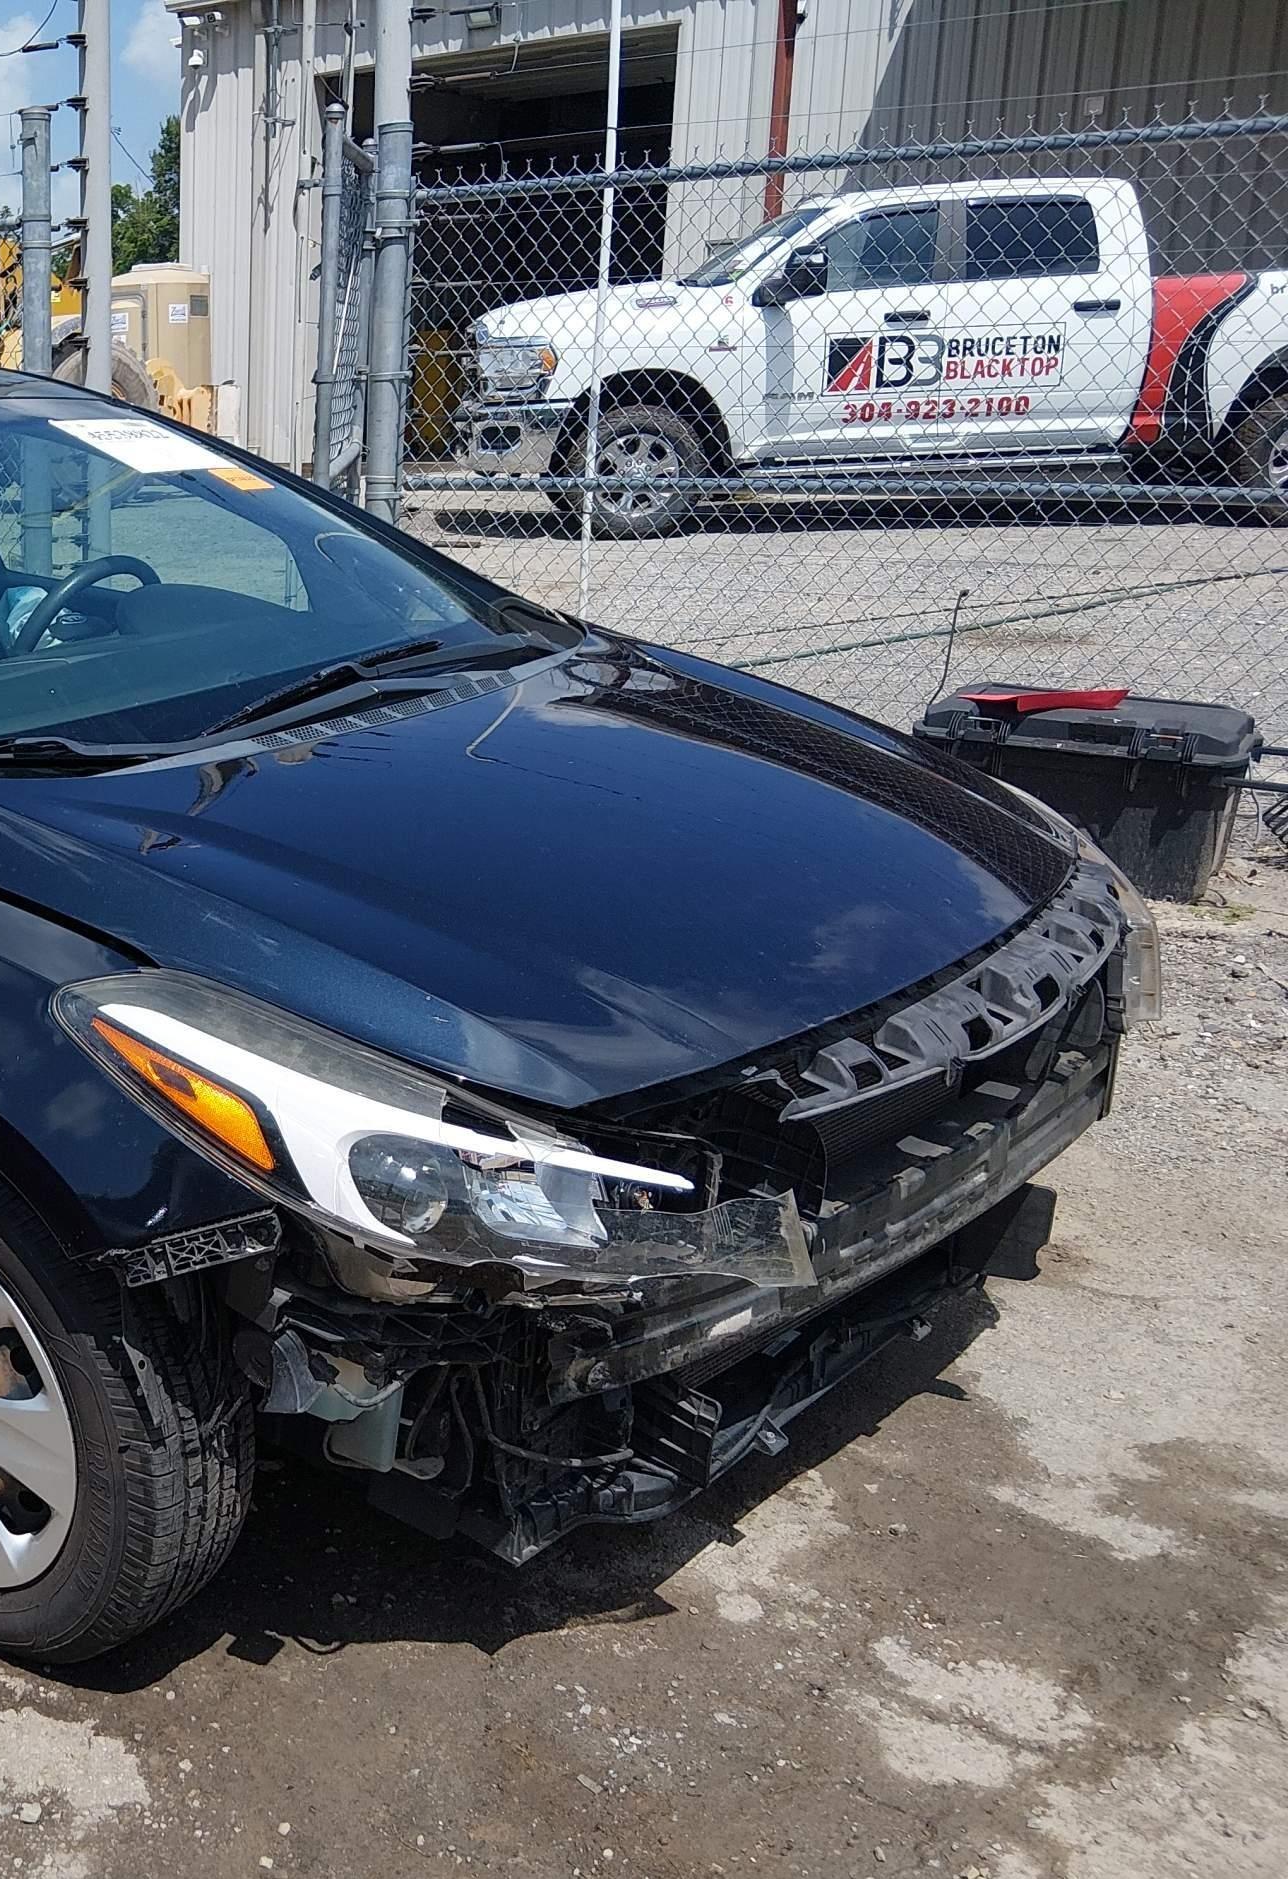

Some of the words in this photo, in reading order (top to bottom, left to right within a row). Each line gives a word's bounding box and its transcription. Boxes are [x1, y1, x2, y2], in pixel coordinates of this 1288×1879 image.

[947, 335, 1062, 358] BRUCETON
[944, 356, 1059, 381] BLACKTOP
[842, 395, 1030, 424] 304-923-2100
